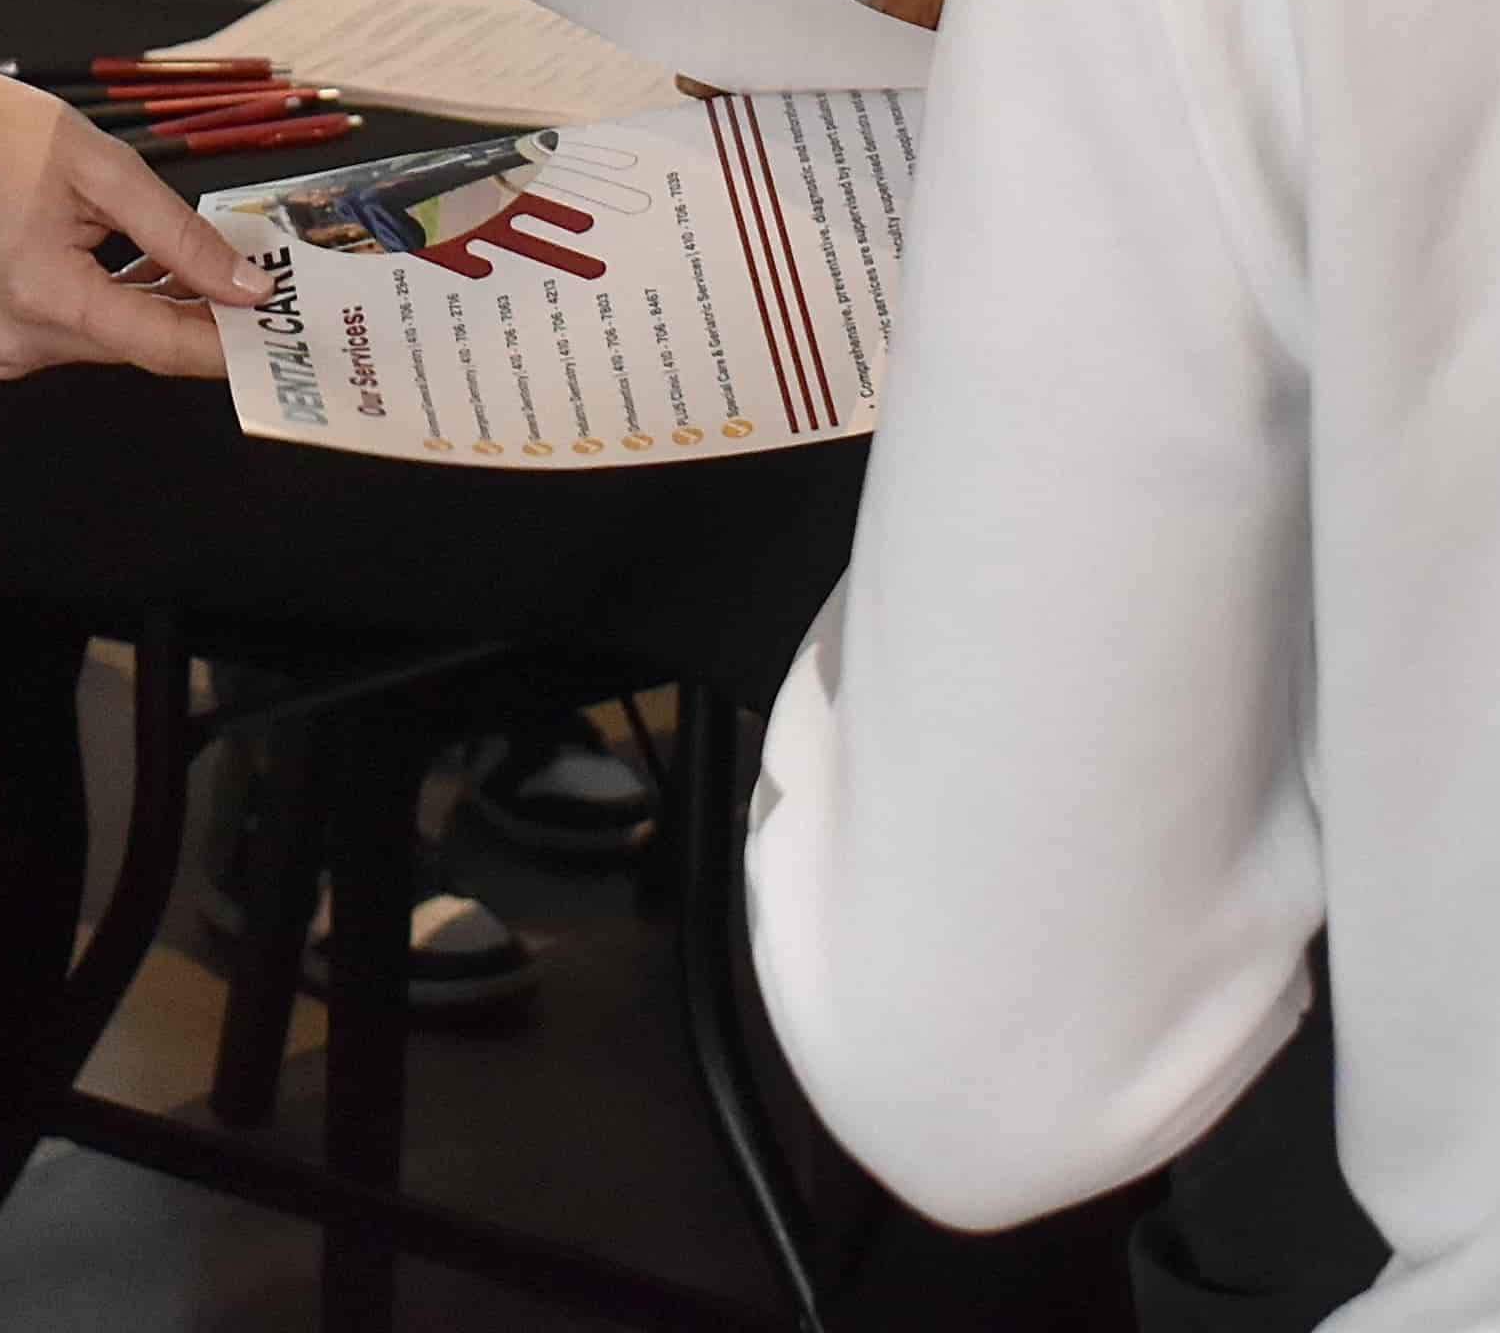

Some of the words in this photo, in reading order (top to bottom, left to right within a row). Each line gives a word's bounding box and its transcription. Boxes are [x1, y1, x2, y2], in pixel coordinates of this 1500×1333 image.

[791, 144, 809, 164] and
[826, 132, 848, 165] expert
[896, 127, 917, 161] people
[836, 165, 852, 181] by
[867, 153, 896, 215] supervised
[800, 164, 827, 224] diagnostic
[674, 203, 690, 225] 706
[839, 180, 870, 245] supervised
[680, 232, 697, 251] 410
[859, 244, 873, 266] are
[818, 225, 852, 305] preventative,
[543, 279, 558, 305] 4213
[689, 256, 710, 302] Services
[865, 267, 890, 317] services
[550, 311, 566, 333] 706
[652, 323, 669, 344] 706
[700, 302, 721, 349] Geriatric
[341, 305, 379, 387] Services:
[604, 327, 620, 348] 706
[660, 350, 675, 369] 410
[711, 349, 724, 358] &
[839, 304, 876, 399] Comprehensive,
[263, 340, 329, 426] DENTAL
[714, 358, 730, 382] Care
[357, 390, 386, 417] Our
[671, 400, 689, 427] PLUS
[719, 382, 741, 419] Special
